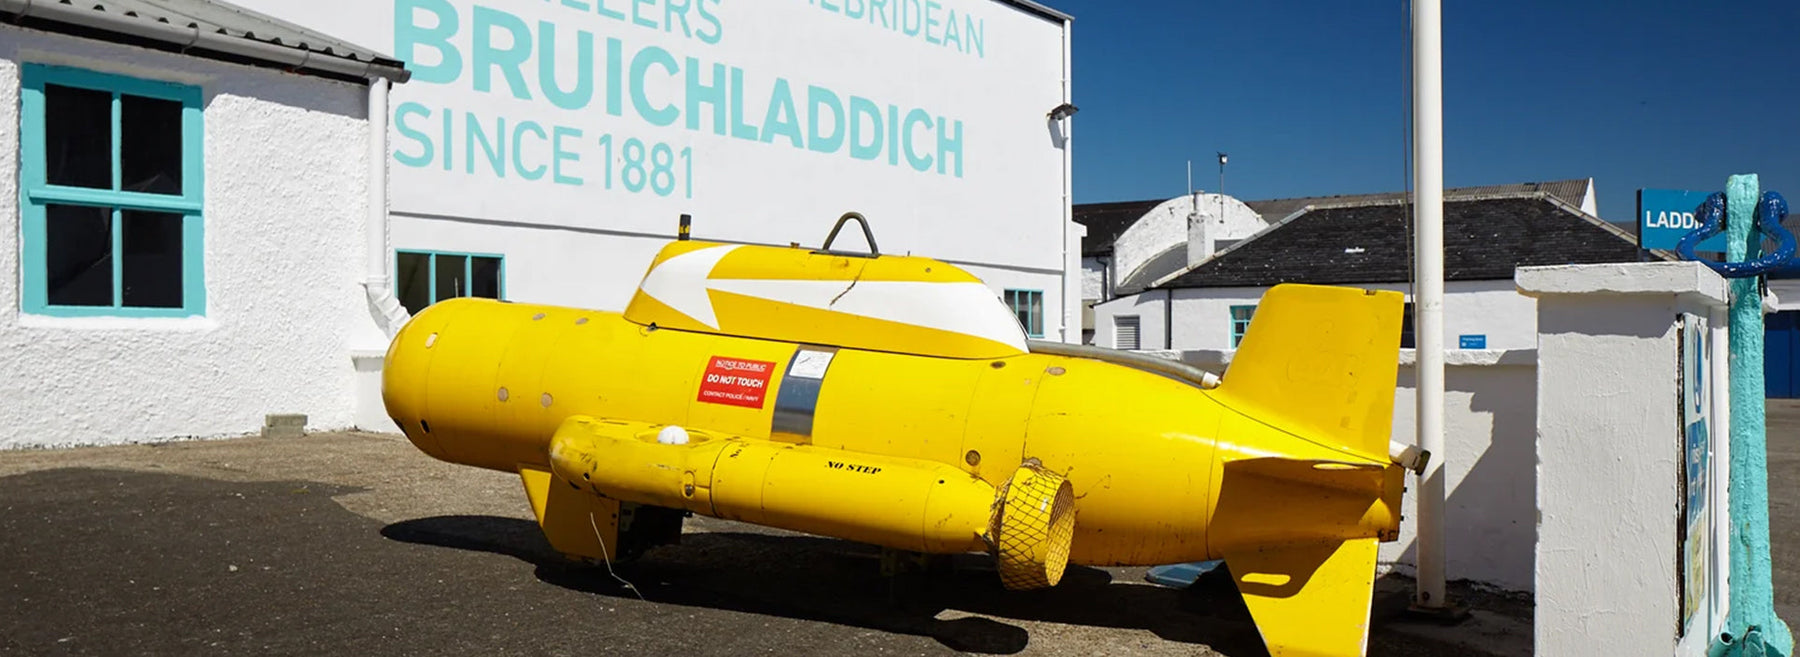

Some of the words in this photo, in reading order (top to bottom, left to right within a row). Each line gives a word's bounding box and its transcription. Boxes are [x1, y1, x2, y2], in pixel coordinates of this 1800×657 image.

[810, 0, 985, 58] RIDEAN
[394, 0, 964, 178] BRUICHLADDICH
[393, 101, 584, 186] SINCE
[600, 133, 692, 199] 1881
[1646, 210, 1704, 230] LADDI
[715, 360, 737, 370] NOTICE
[745, 362, 767, 371] PUBLIC
[707, 373, 719, 383] DO
[720, 375, 737, 385] NOT
[737, 376, 764, 388] TOUCH
[704, 390, 725, 398] CONTACT
[826, 460, 844, 470] NO
[846, 463, 882, 475] STEP
